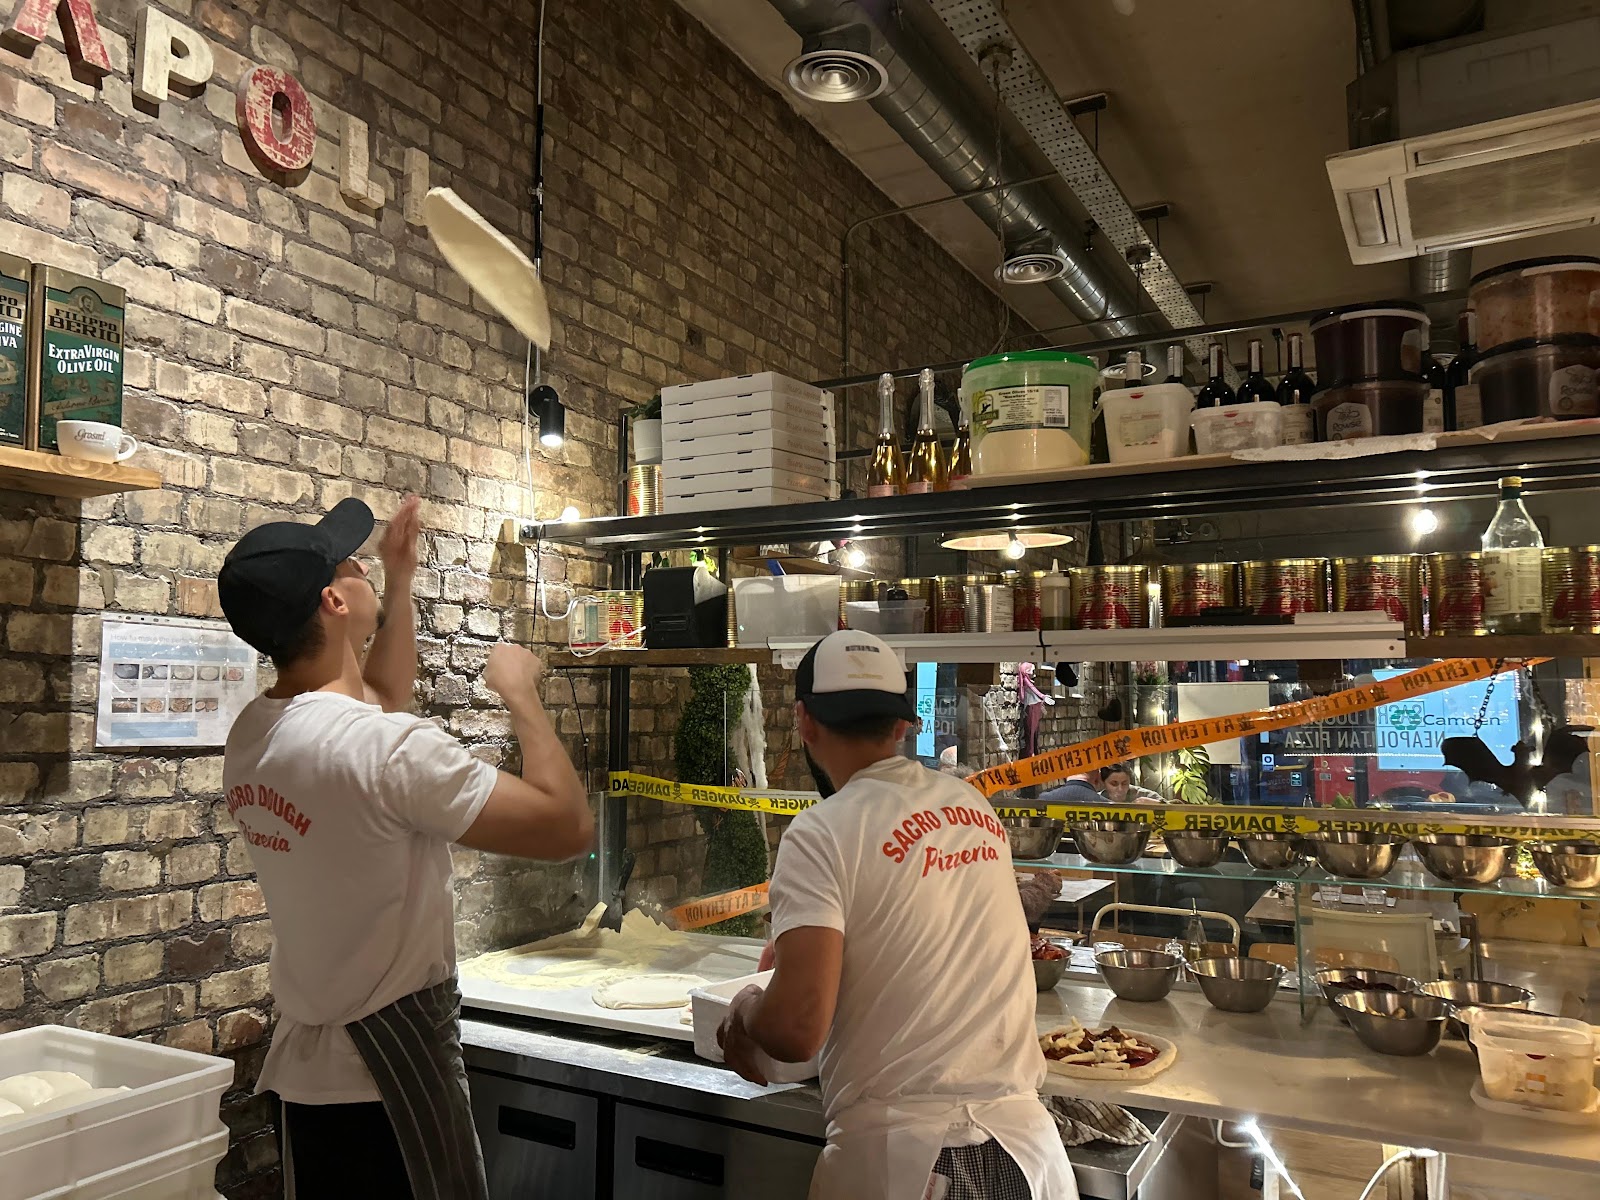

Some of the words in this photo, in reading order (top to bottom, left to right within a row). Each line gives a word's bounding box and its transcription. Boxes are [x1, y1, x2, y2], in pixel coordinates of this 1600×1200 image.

[48, 315, 120, 344] BERIO
[54, 308, 117, 332] FILIPPO
[57, 359, 93, 374] OLIVE
[94, 358, 114, 374] OIL
[258, 784, 312, 837] DOUGH
[882, 810, 942, 864] SACRO
[940, 806, 1007, 844] DOUGH
[921, 840, 1000, 878] Pizzeria
